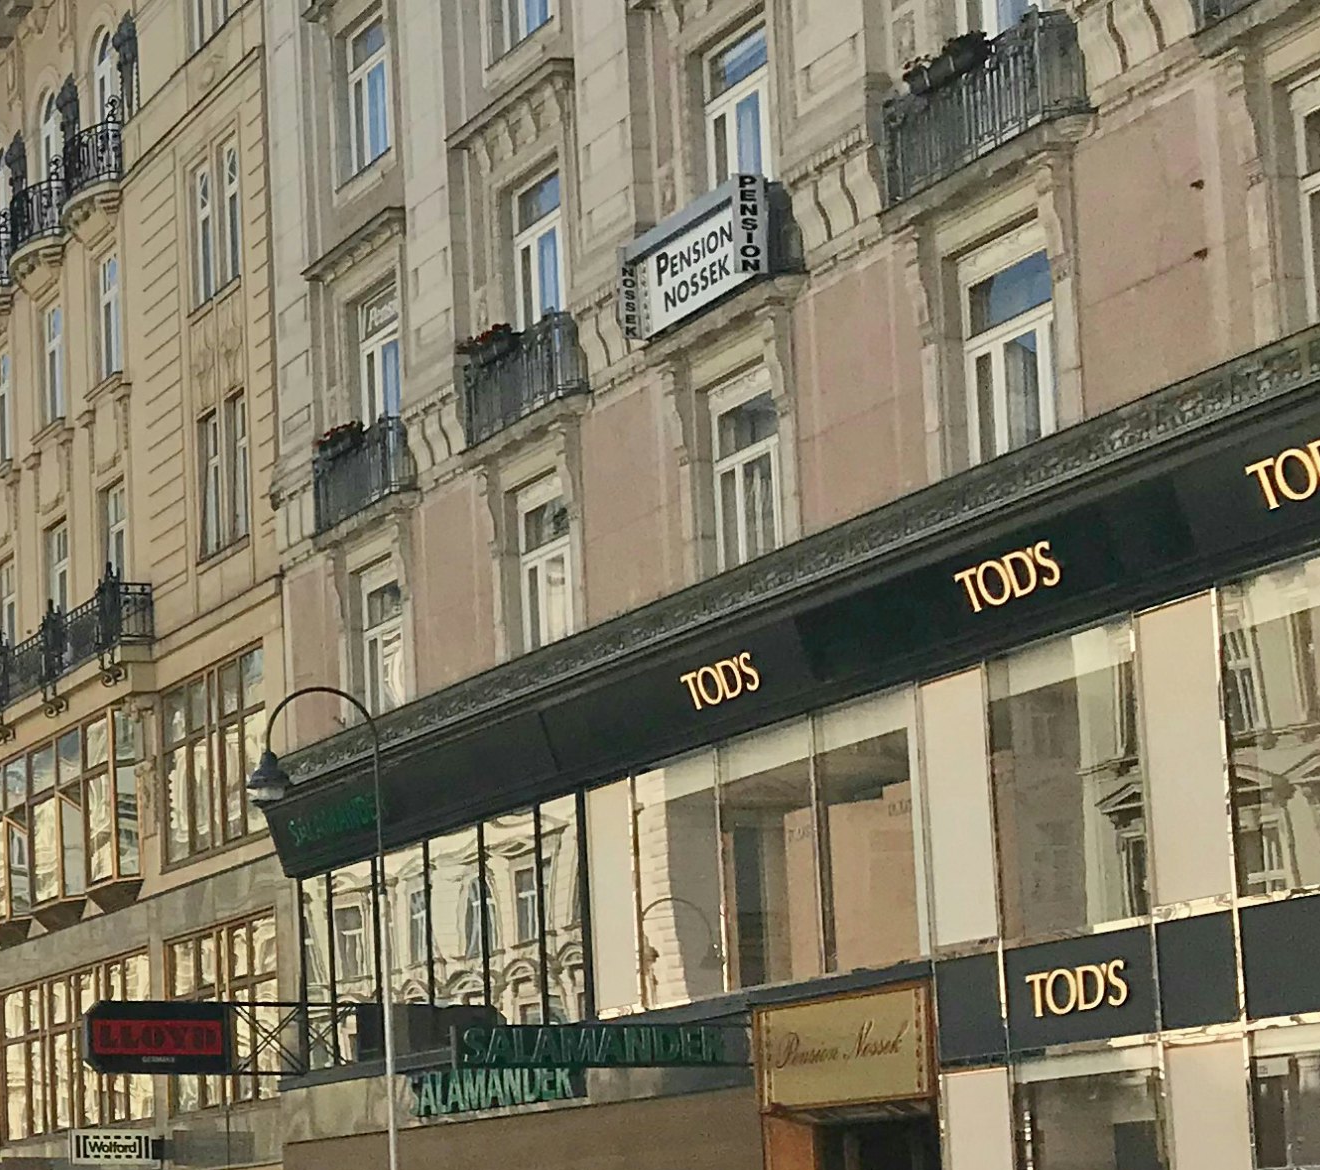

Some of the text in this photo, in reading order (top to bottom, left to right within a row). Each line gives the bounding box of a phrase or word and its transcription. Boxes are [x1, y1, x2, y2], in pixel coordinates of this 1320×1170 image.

[655, 221, 733, 287] PENSION
[738, 175, 761, 272] PENSION
[621, 267, 638, 337] NOSSEK
[663, 254, 730, 313] NOSSEK
[954, 539, 1061, 613] TOD'S
[680, 651, 759, 712] TOD'S
[1025, 958, 1129, 1019] TOD'S
[100, 1025, 217, 1048] LLOYD
[462, 1026, 725, 1064] SALAMANDER
[776, 1018, 909, 1069] Pension Nossek
[88, 1140, 137, 1154] Wolford
